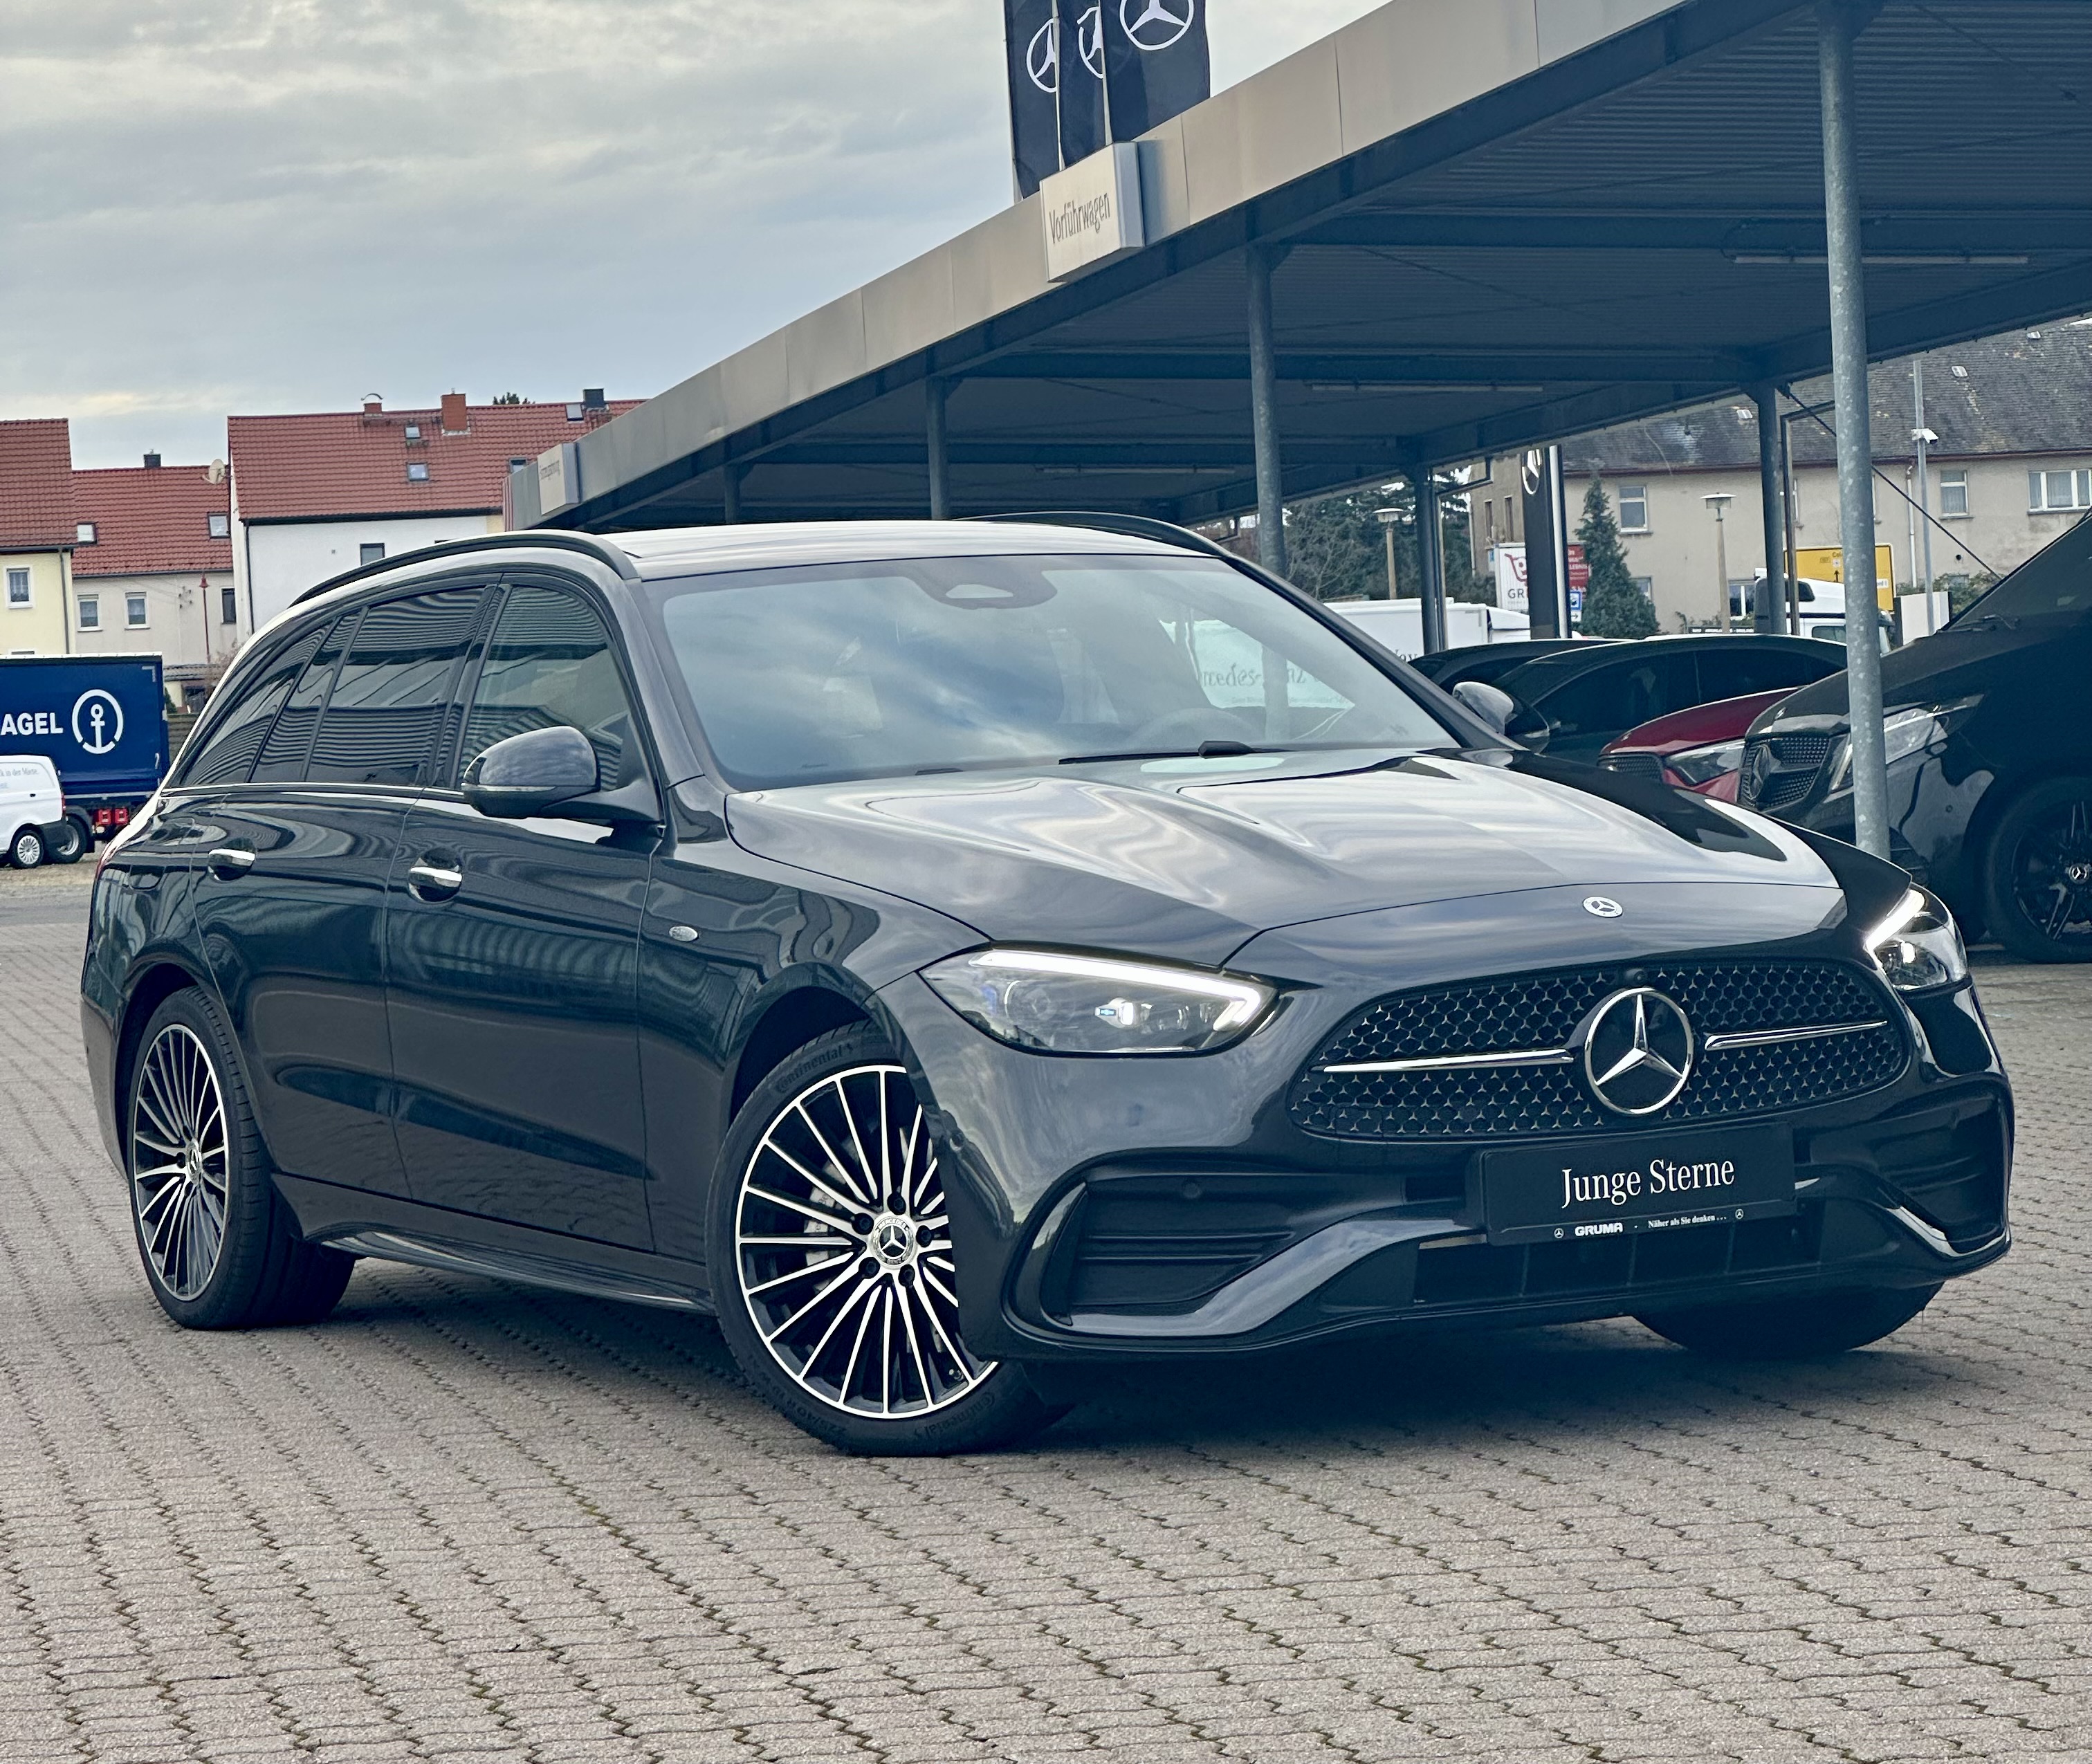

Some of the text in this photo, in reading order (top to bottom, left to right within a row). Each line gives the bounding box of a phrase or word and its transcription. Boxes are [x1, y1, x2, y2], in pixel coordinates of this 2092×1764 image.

[1049, 193, 1110, 245] Vorführwagen
[0, 712, 64, 736] AGEL
[1561, 1159, 1734, 1209] Junge Sterne
[1575, 1222, 1623, 1237] GRUMA
[1648, 1220, 1669, 1229] Näher
[1670, 1218, 1680, 1226] als
[1680, 1216, 1691, 1225] Sie
